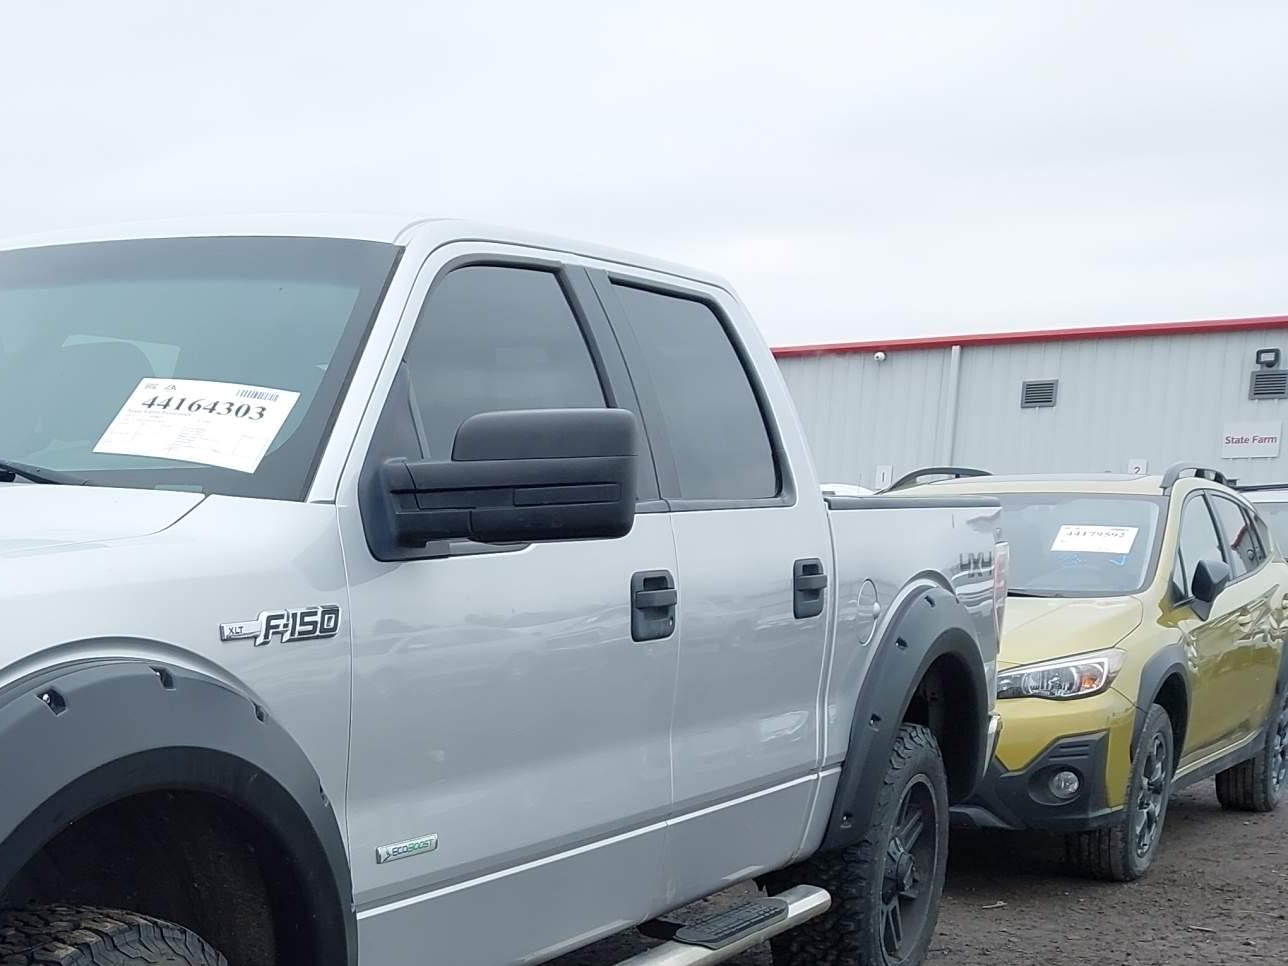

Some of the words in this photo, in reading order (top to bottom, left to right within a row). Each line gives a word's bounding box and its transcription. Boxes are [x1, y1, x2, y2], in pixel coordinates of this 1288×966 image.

[142, 395, 267, 421] 44164303
[1225, 436, 1249, 444] State
[1252, 436, 1277, 444] Farm
[228, 626, 244, 635] XLT
